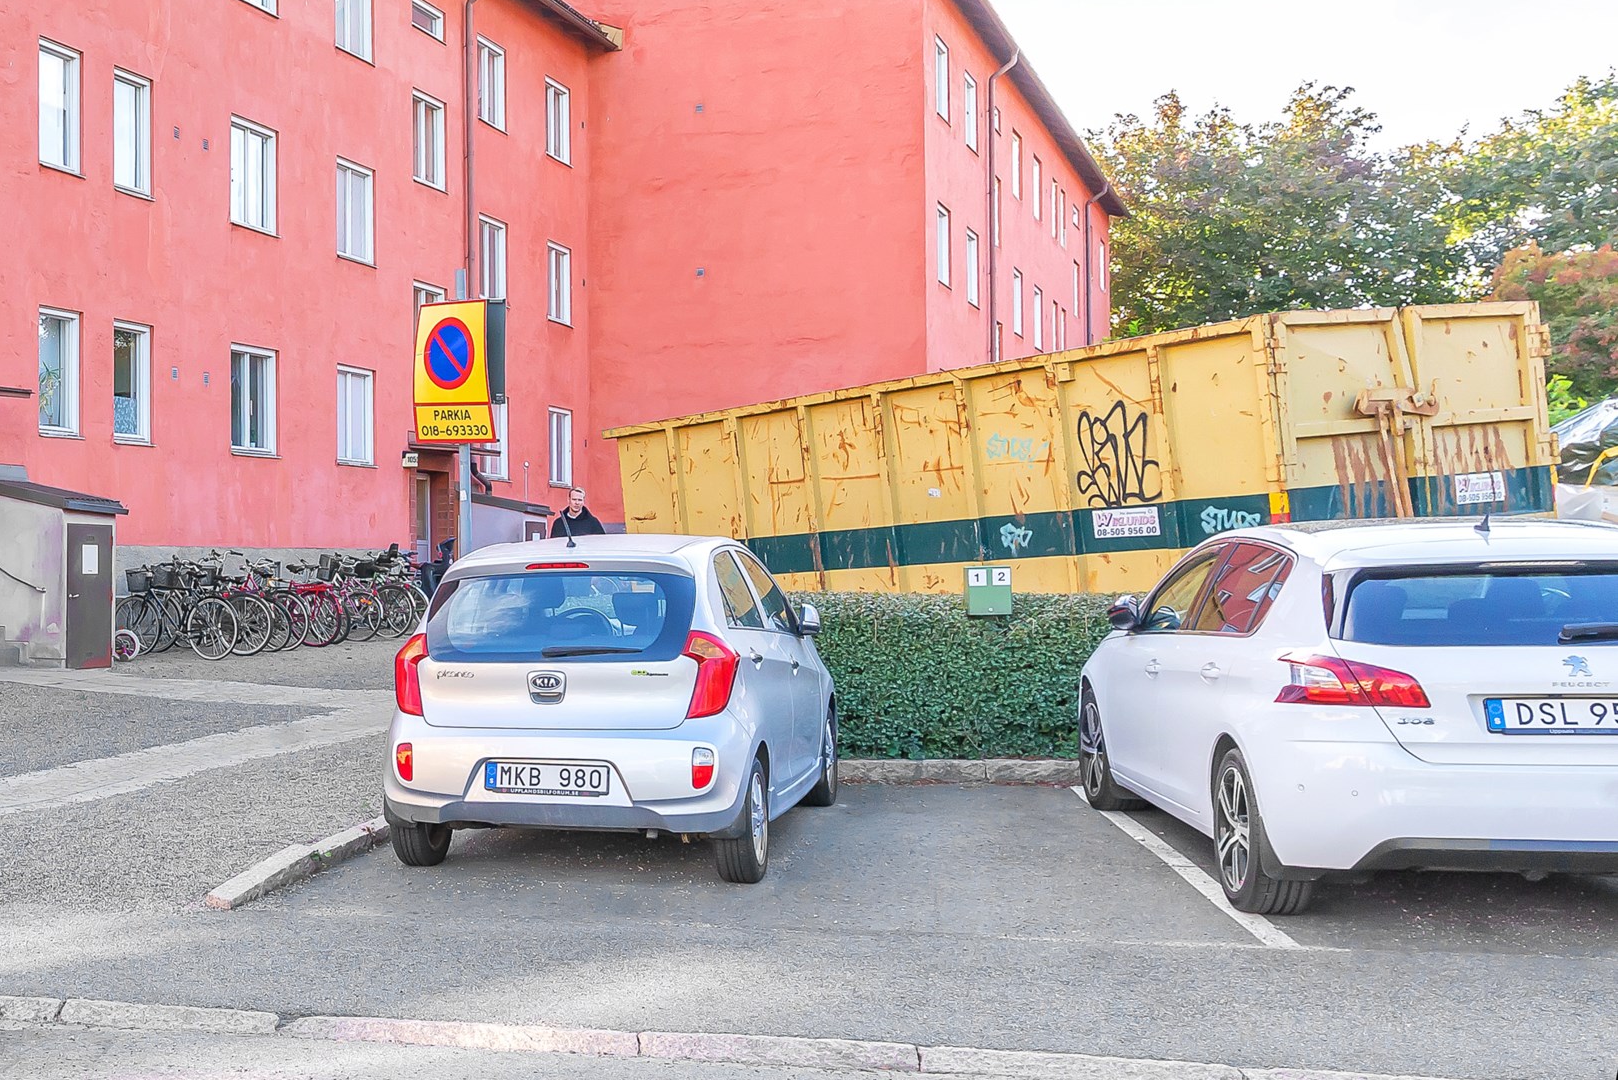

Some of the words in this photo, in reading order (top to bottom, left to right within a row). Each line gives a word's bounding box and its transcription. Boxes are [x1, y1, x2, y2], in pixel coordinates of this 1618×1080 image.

[433, 409, 472, 421] PARKIA
[421, 424, 489, 437] 018-693330
[1097, 527, 1126, 537] 08-505
[1128, 526, 1144, 535] 956
[1146, 525, 1157, 534] 00
[974, 573, 979, 582] 1
[998, 572, 1006, 581] 2
[535, 678, 557, 687] KIA
[1515, 702, 1579, 726] DSL
[500, 766, 541, 787] MKB
[559, 768, 602, 789] 980
